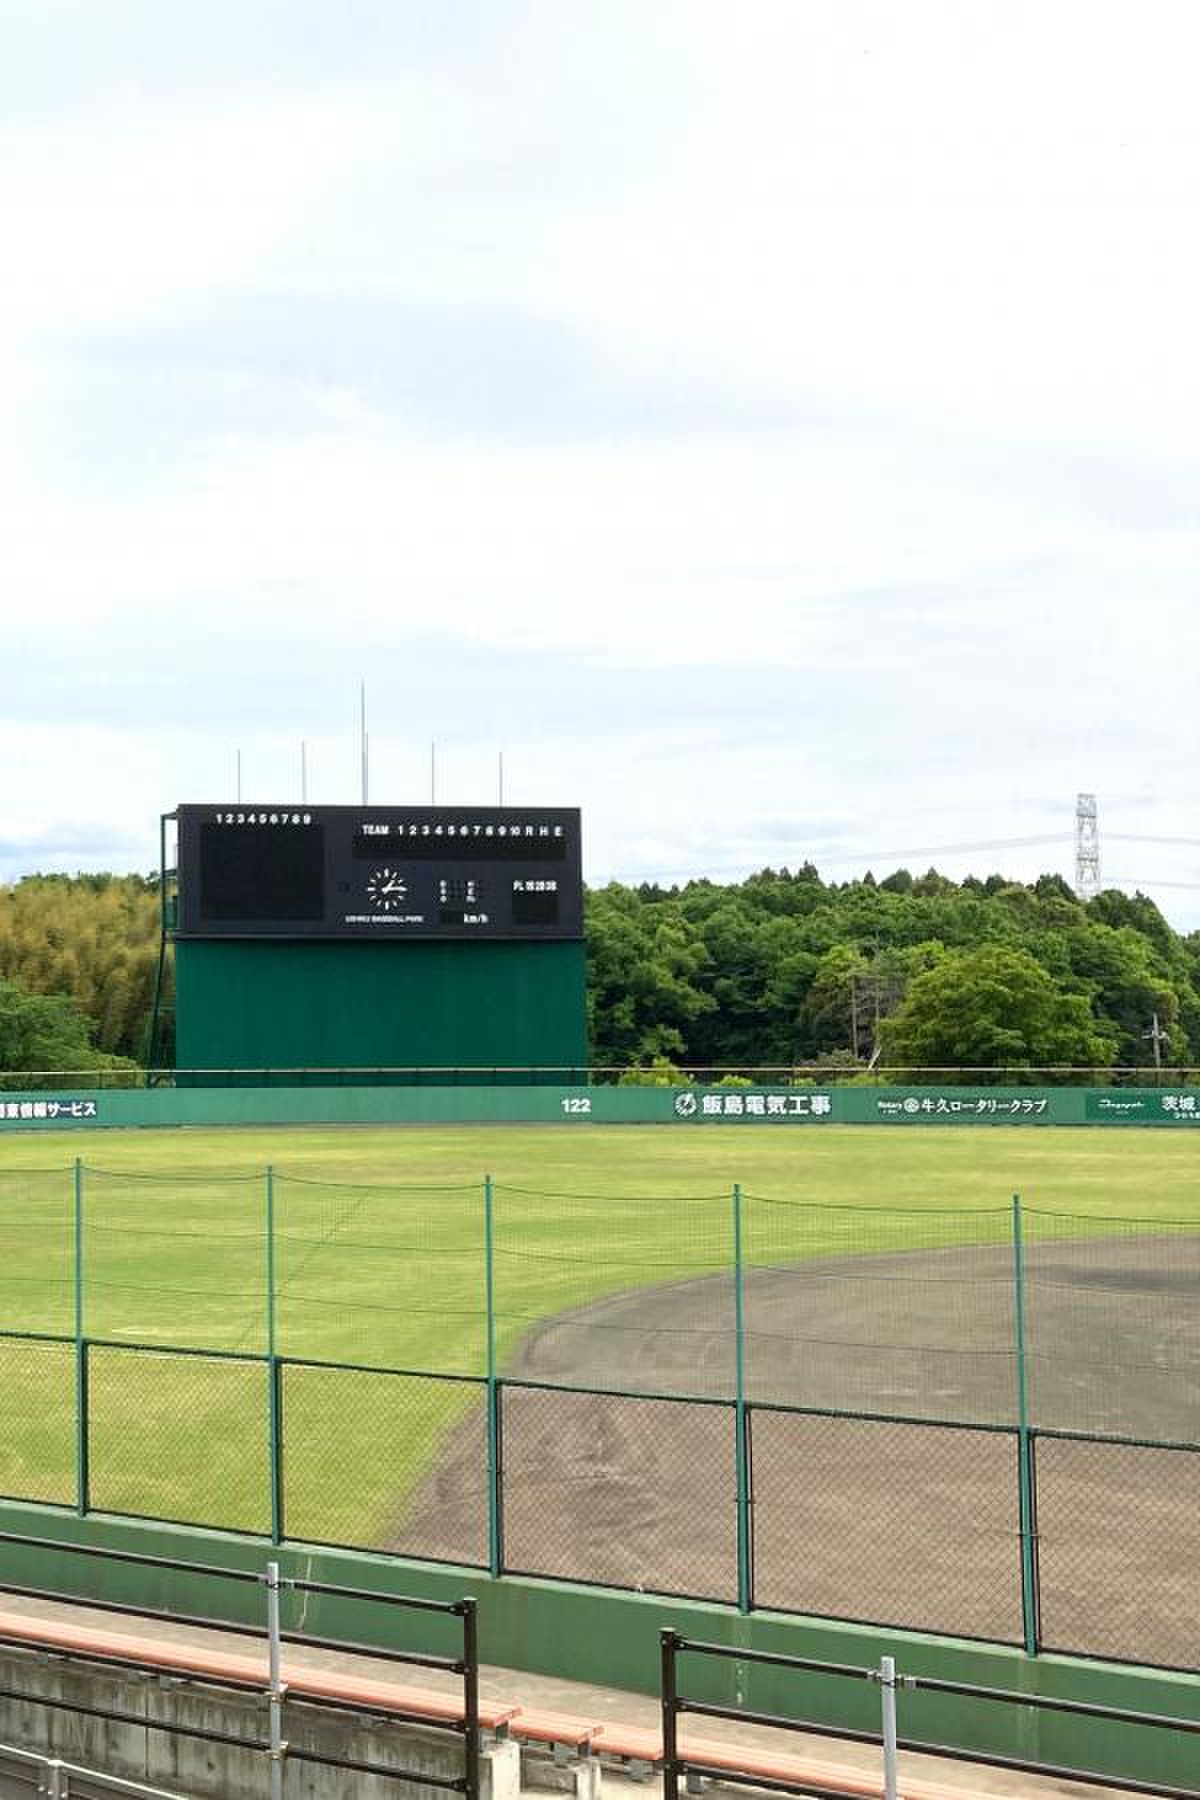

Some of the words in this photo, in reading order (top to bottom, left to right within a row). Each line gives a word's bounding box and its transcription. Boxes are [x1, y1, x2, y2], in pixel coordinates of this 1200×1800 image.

[362, 825, 390, 836] TEAM
[464, 912, 489, 924] km/h
[561, 1098, 592, 1114] 122
[702, 1095, 831, 1116] 飯島電気工事
[921, 1096, 1048, 1114] 牛久ロータリークラブ
